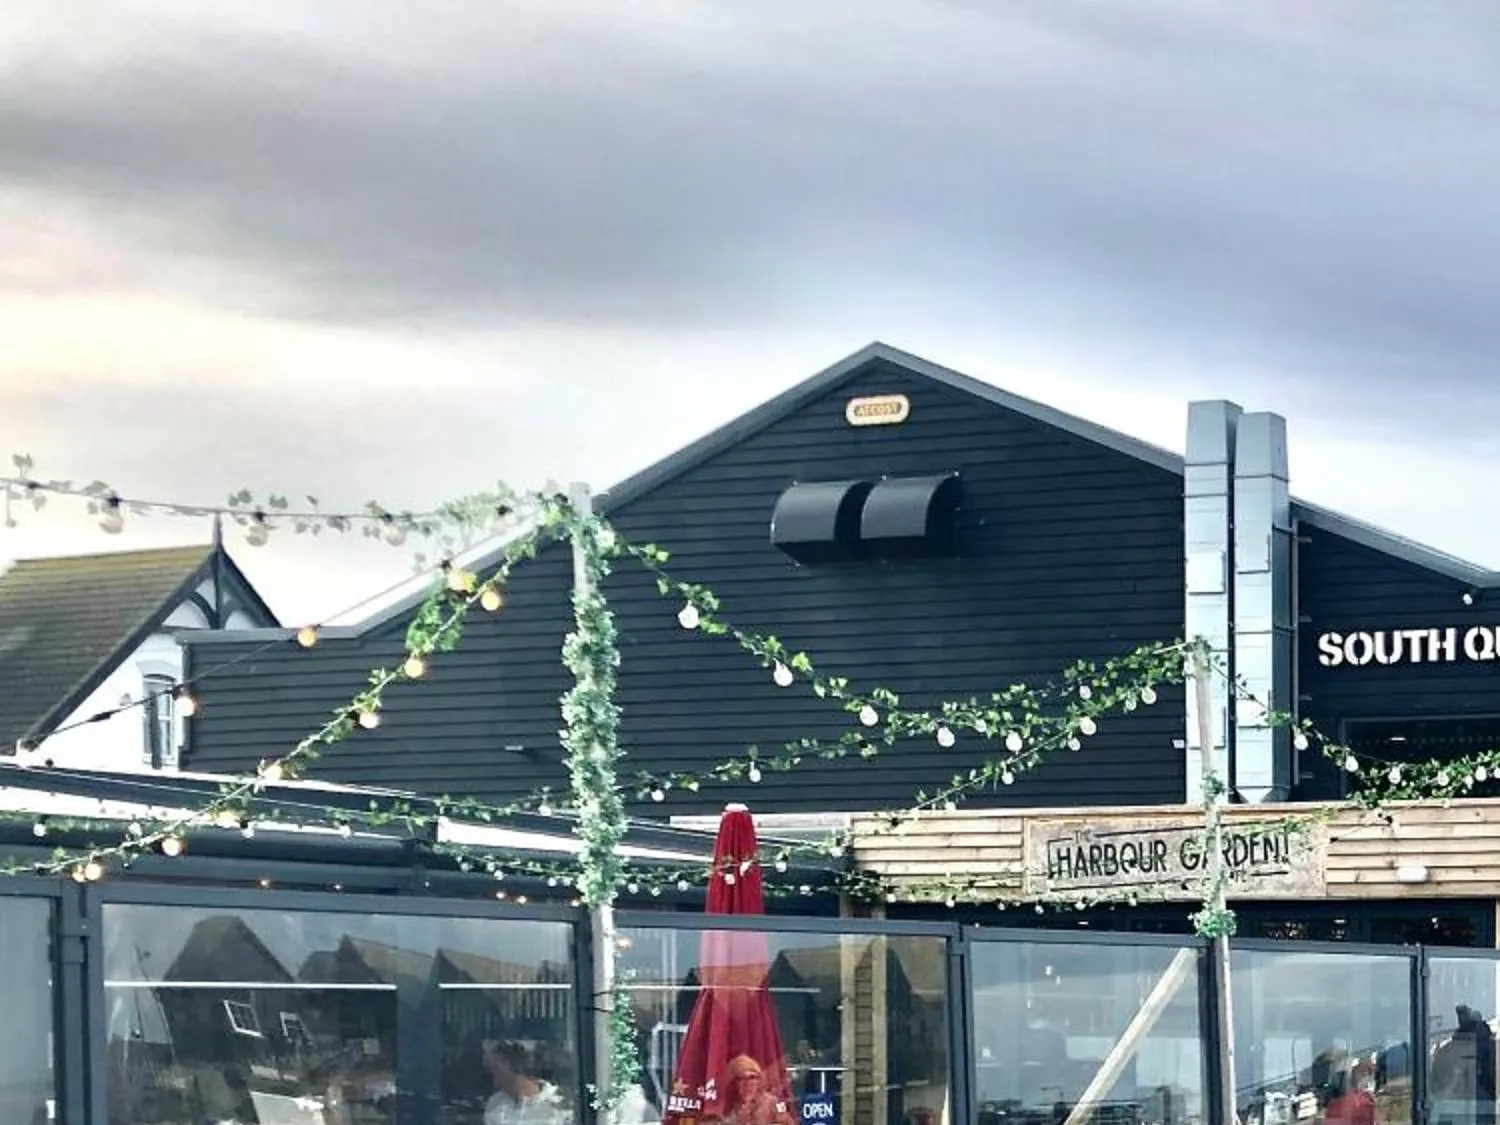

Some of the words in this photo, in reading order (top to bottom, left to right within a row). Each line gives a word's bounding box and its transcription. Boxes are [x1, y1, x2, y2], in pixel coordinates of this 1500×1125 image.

[1318, 627, 1455, 666] SOUTH
[1057, 840, 1167, 878] HARBOUR
[803, 1102, 833, 1118] OPEN
